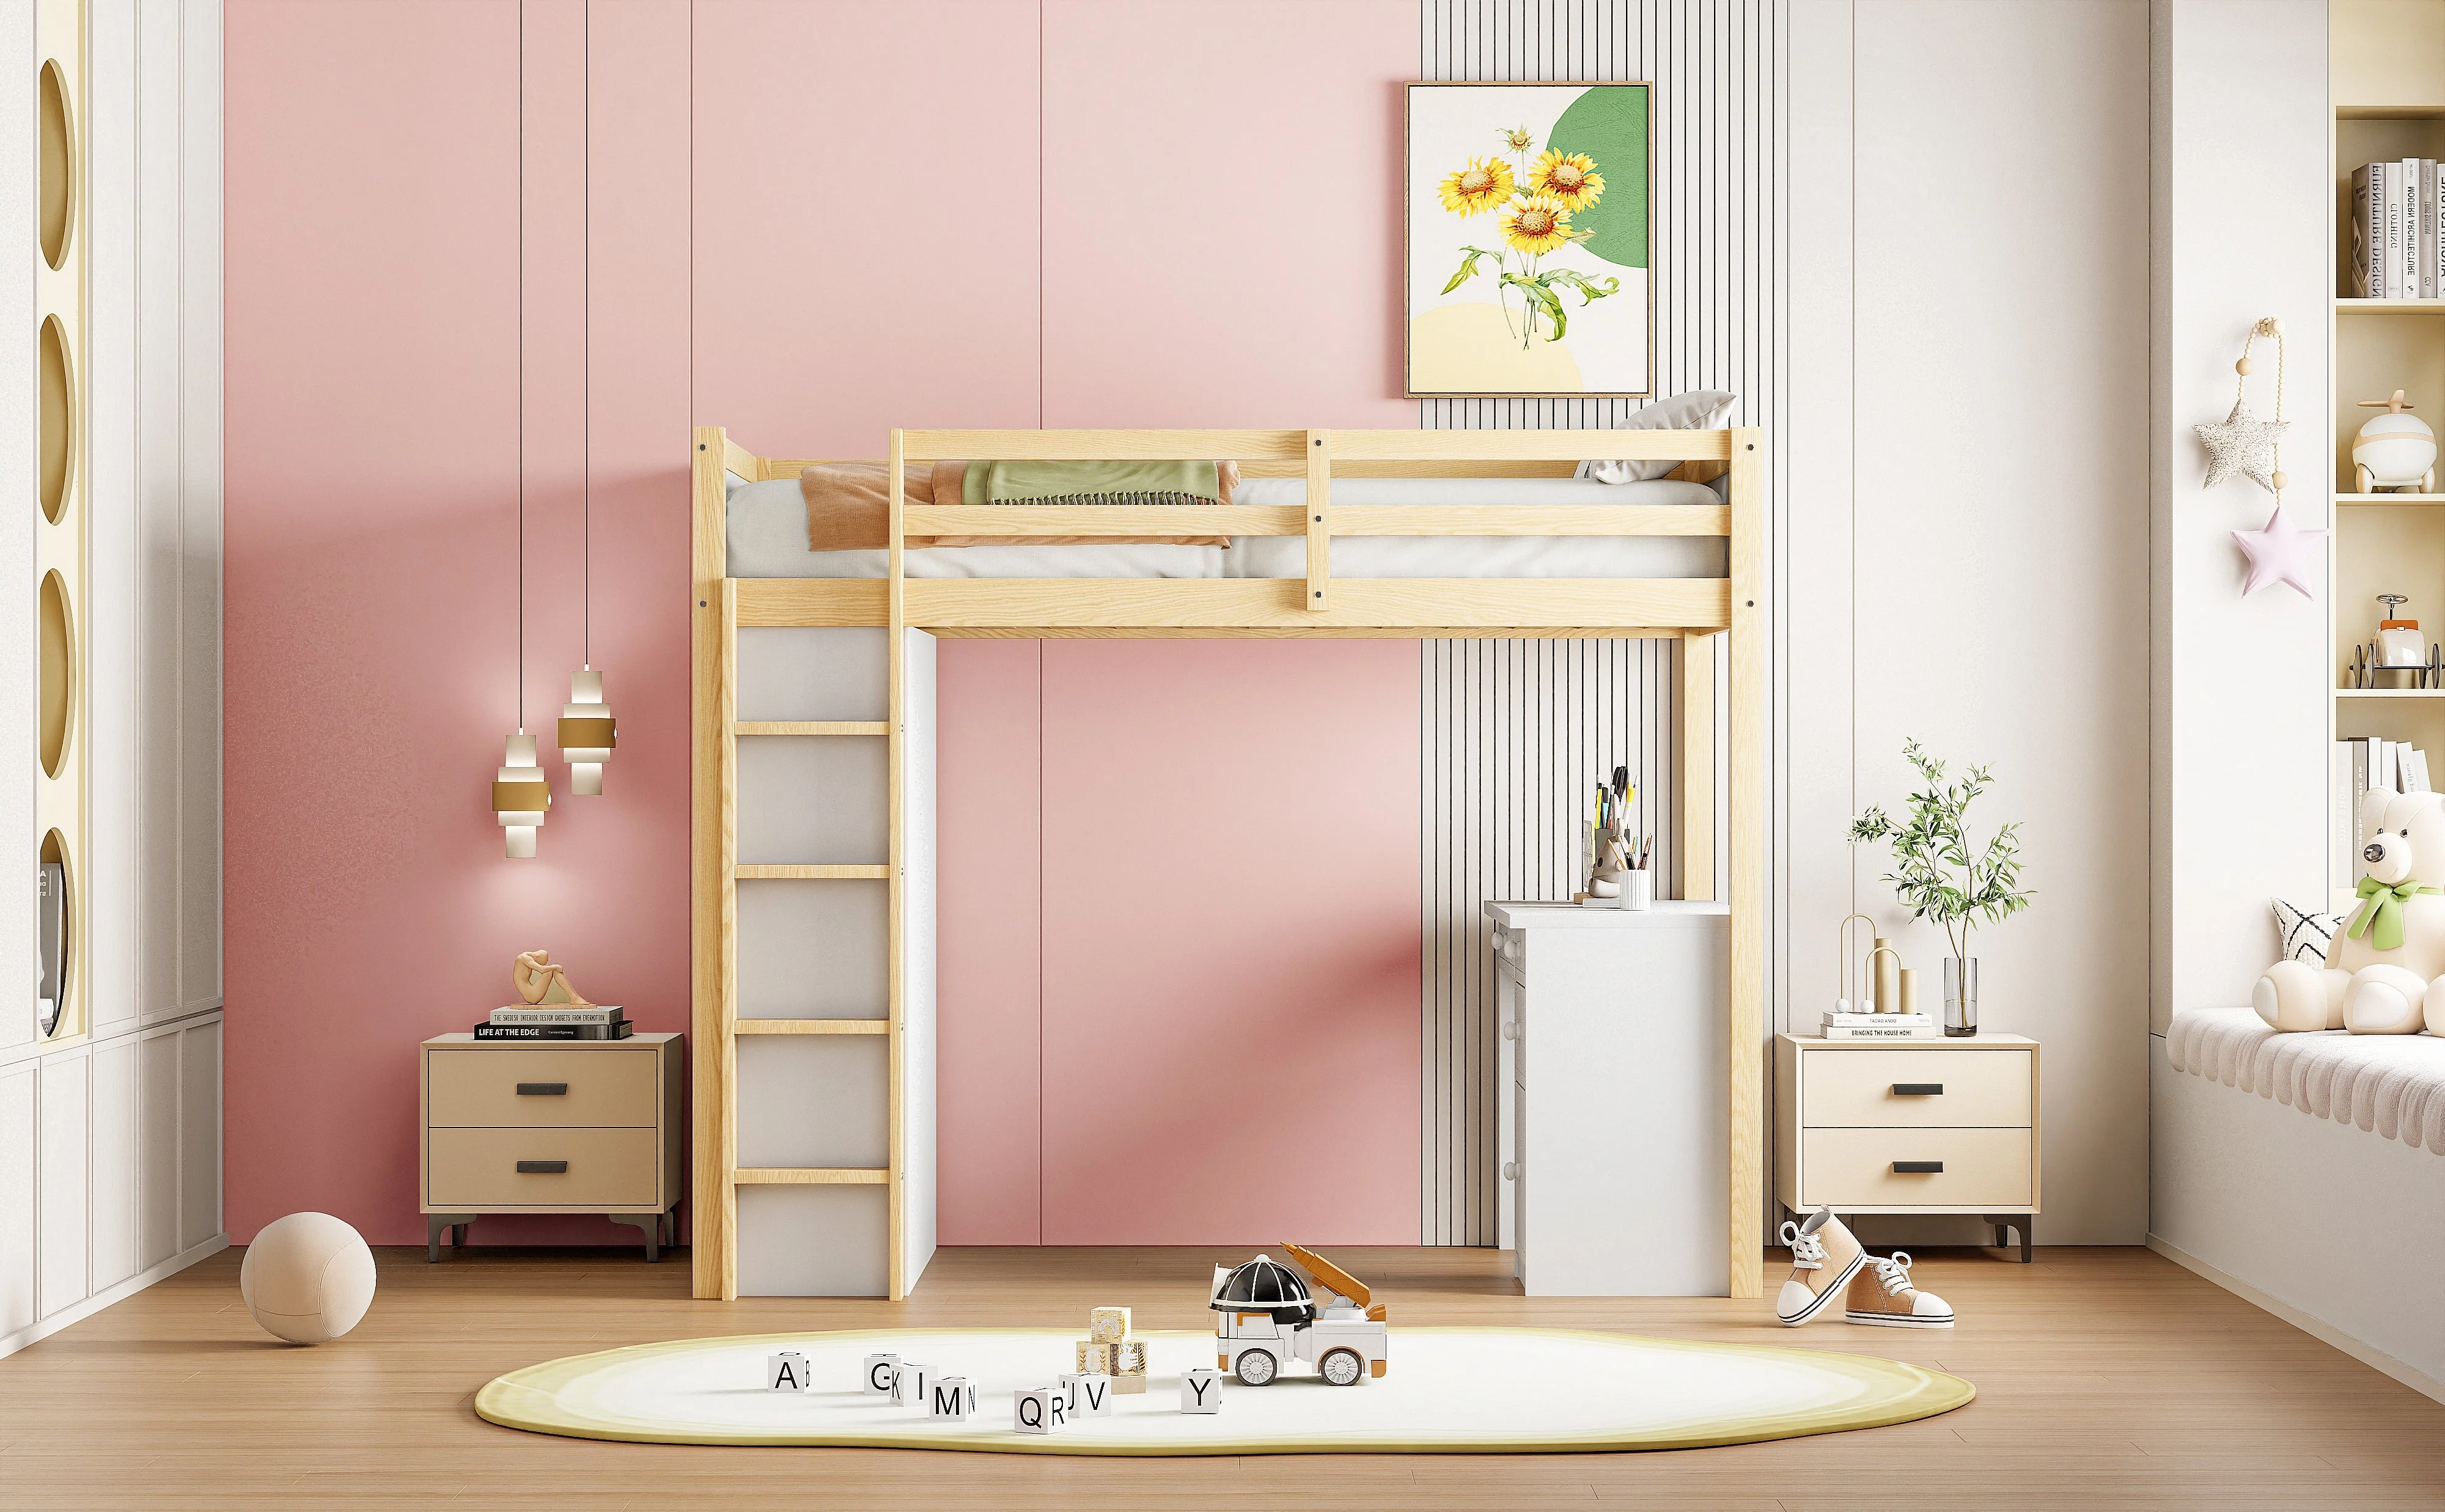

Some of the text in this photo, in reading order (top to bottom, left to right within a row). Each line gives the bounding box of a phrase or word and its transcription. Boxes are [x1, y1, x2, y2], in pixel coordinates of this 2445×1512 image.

[774, 1362, 798, 1389] A
[892, 1370, 901, 1400] K
[919, 1372, 923, 1400] I
[935, 1386, 960, 1415] M
[1086, 1381, 1106, 1411] V
[1188, 1378, 1212, 1406] Y
[1020, 1396, 1042, 1429] Q
[1052, 1396, 1065, 1426] R
